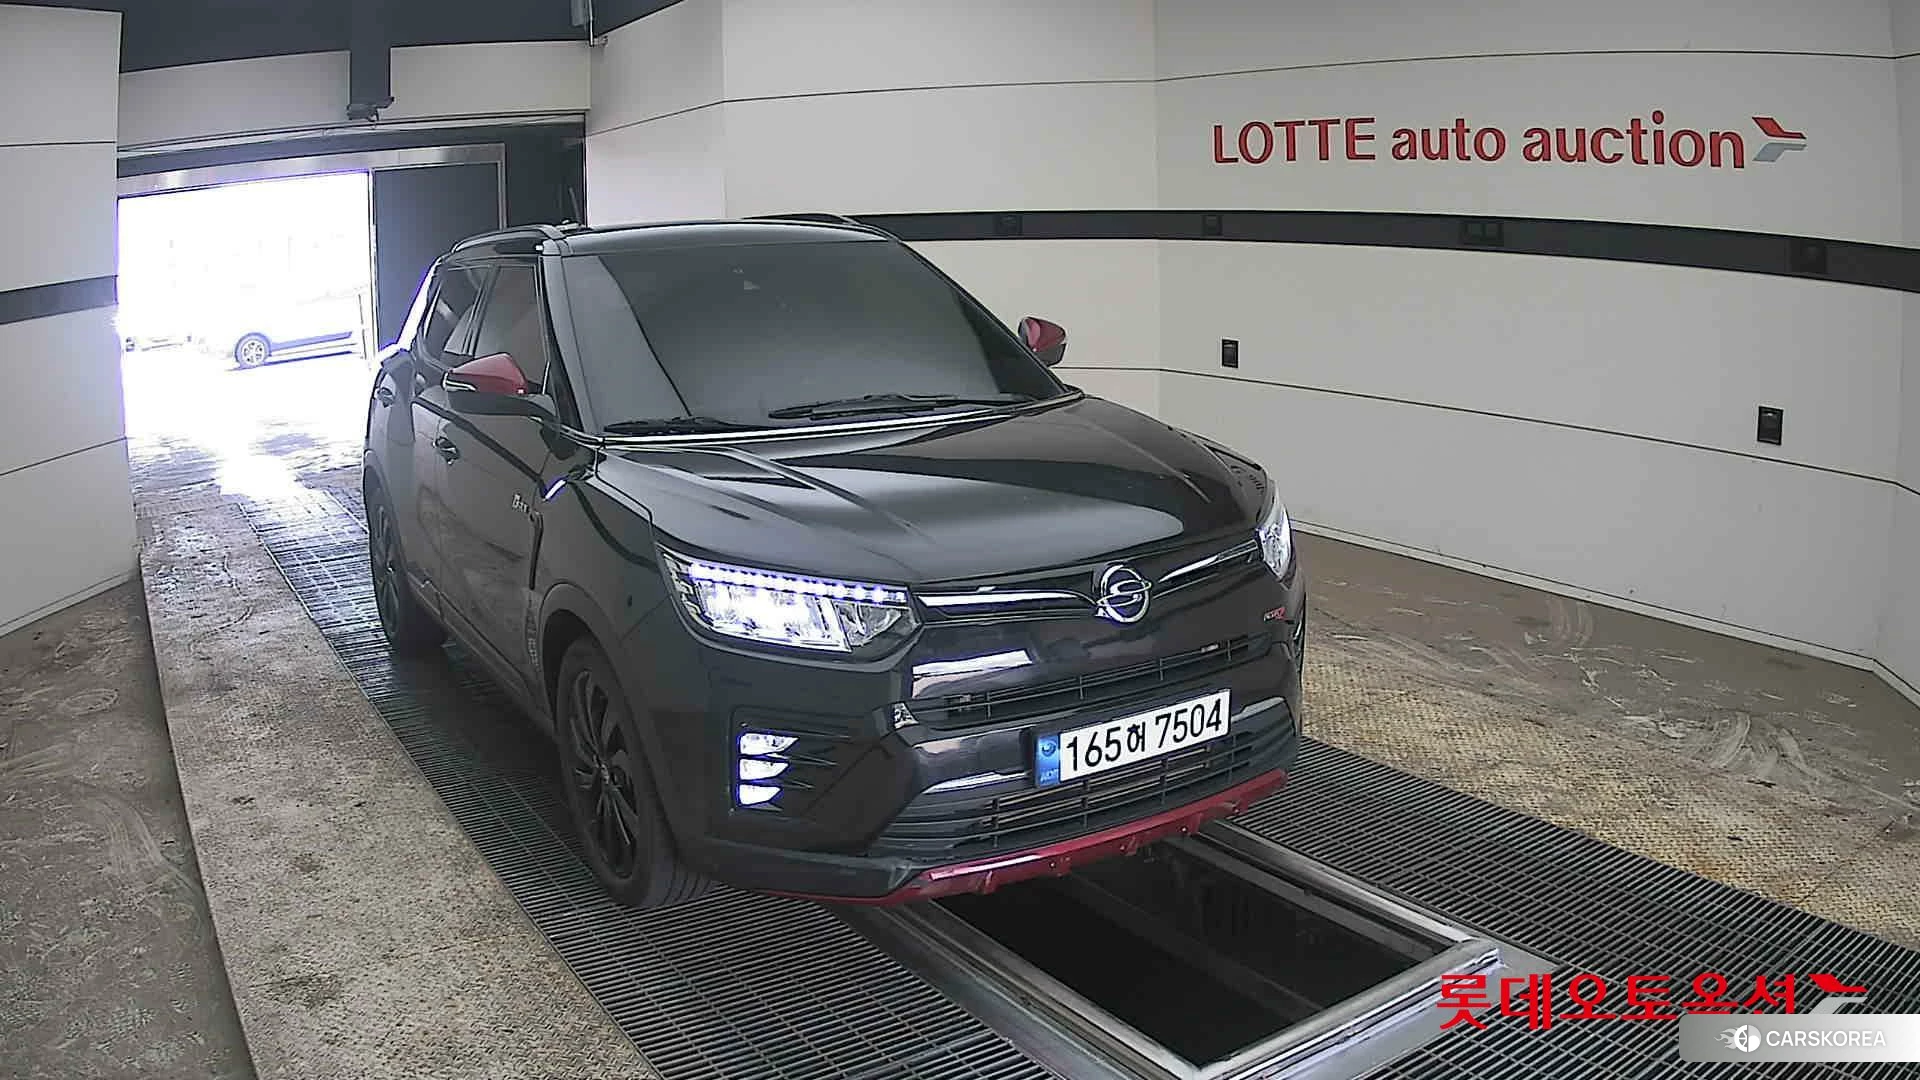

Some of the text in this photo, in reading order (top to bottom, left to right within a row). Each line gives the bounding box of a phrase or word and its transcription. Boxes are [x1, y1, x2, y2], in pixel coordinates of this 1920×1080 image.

[1212, 110, 1745, 169] LOTTE auto auction
[1066, 698, 1222, 772] 165허 7504
